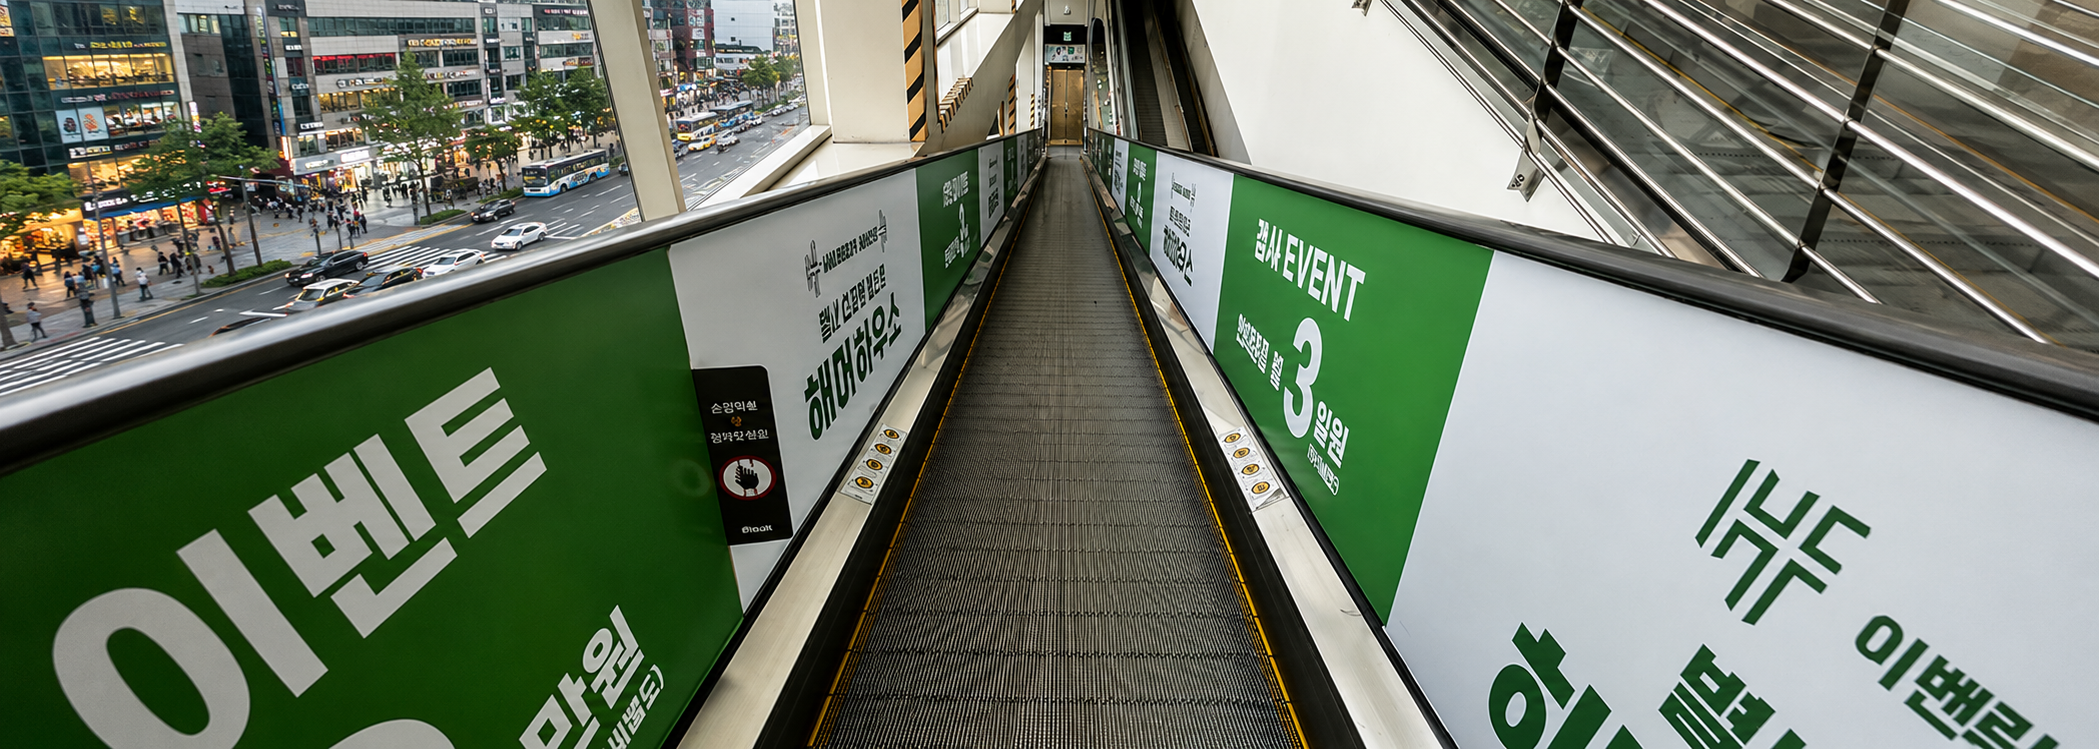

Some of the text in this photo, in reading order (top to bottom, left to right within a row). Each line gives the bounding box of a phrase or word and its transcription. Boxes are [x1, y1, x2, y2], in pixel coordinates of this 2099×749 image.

[1282, 233, 1366, 322] EVENT
[1283, 317, 1322, 438] 3
[53, 367, 547, 749] 이벤트
